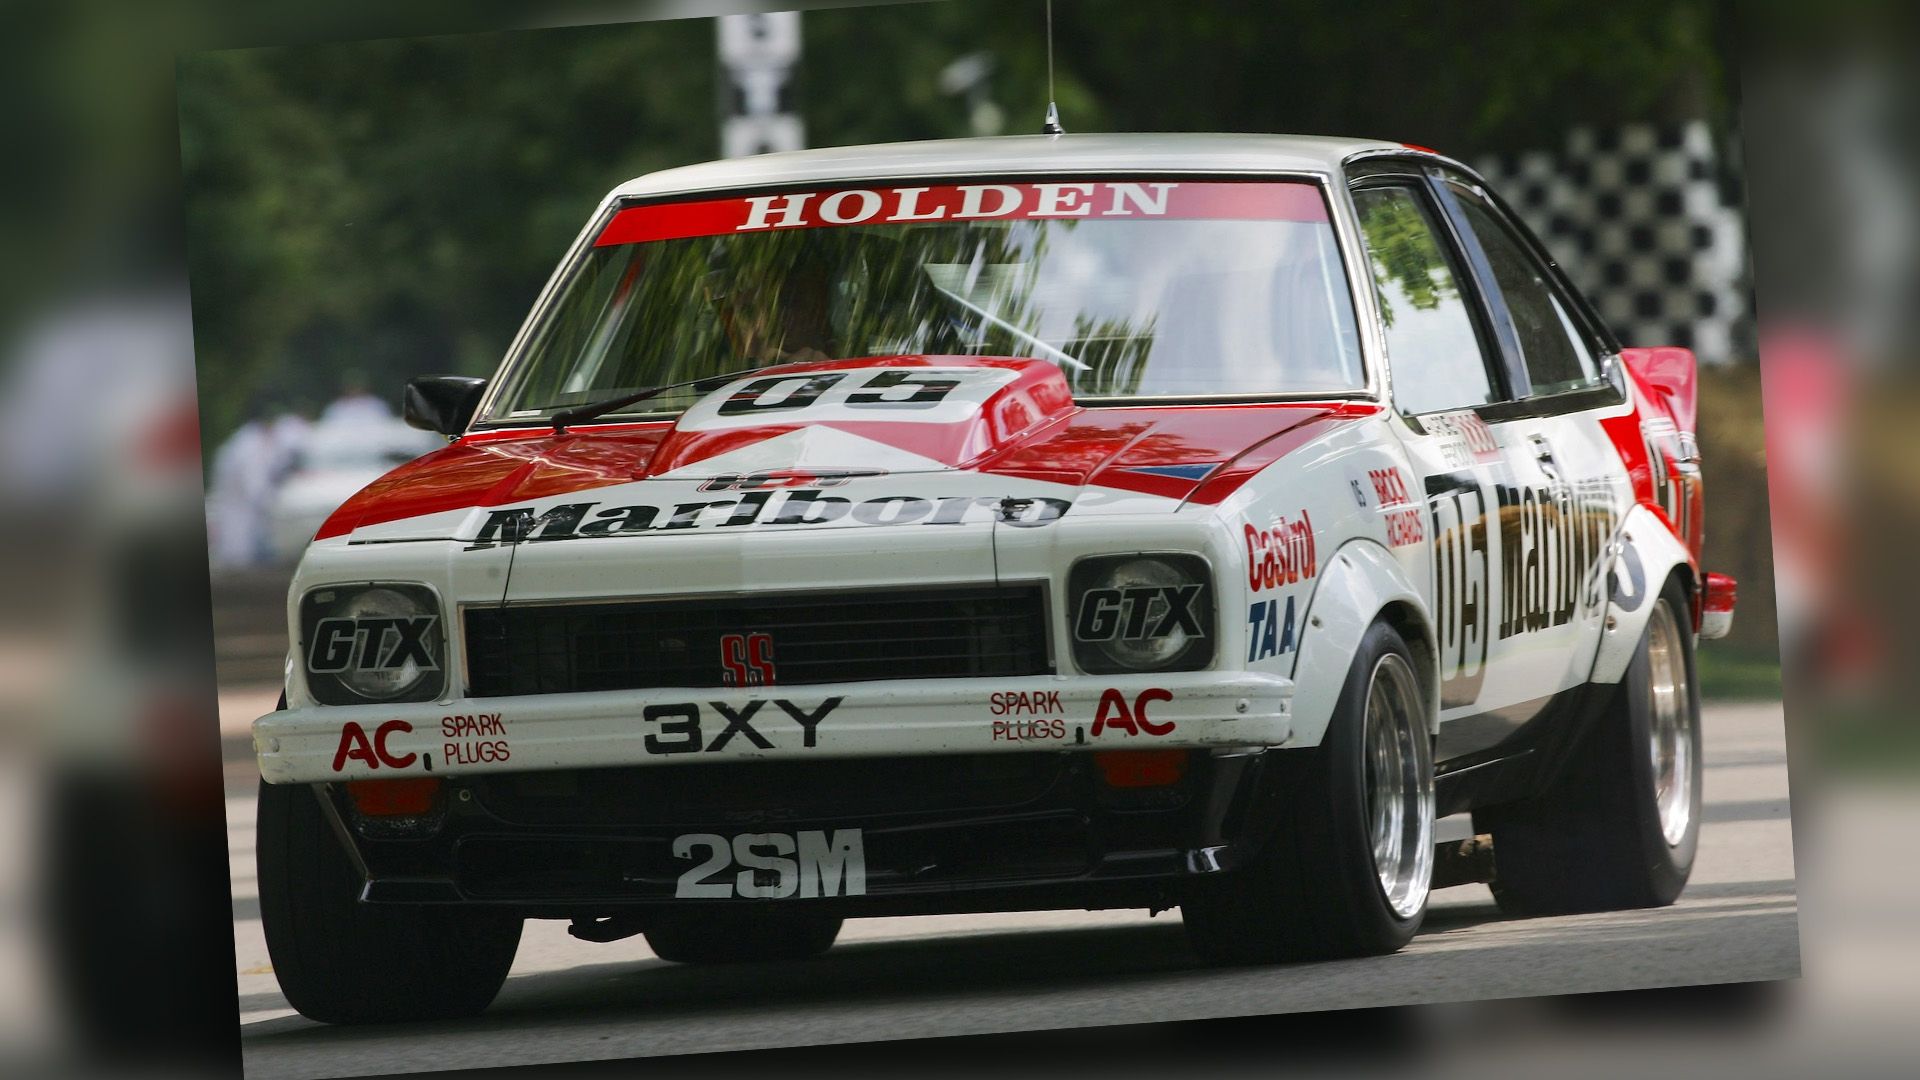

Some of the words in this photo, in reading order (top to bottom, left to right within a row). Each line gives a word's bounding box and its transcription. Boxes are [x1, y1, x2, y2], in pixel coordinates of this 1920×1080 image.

[736, 182, 1178, 231] HOLDEN
[717, 373, 962, 416] 05
[464, 489, 1071, 551] Marlboro
[1244, 509, 1316, 592] Castrol
[1075, 583, 1206, 642] GTX
[1424, 473, 1489, 711] 05
[308, 614, 441, 674] GTX
[1248, 595, 1296, 663] TAA
[720, 633, 776, 689] SS
[442, 713, 506, 738] SPARK
[643, 696, 846, 754] 3XY
[990, 691, 1065, 716] SPARK
[992, 719, 1066, 741] PLUGS
[1090, 688, 1177, 737] AC
[332, 720, 418, 772] AC
[444, 741, 510, 765] PLUGS
[672, 828, 867, 899] 2SM
